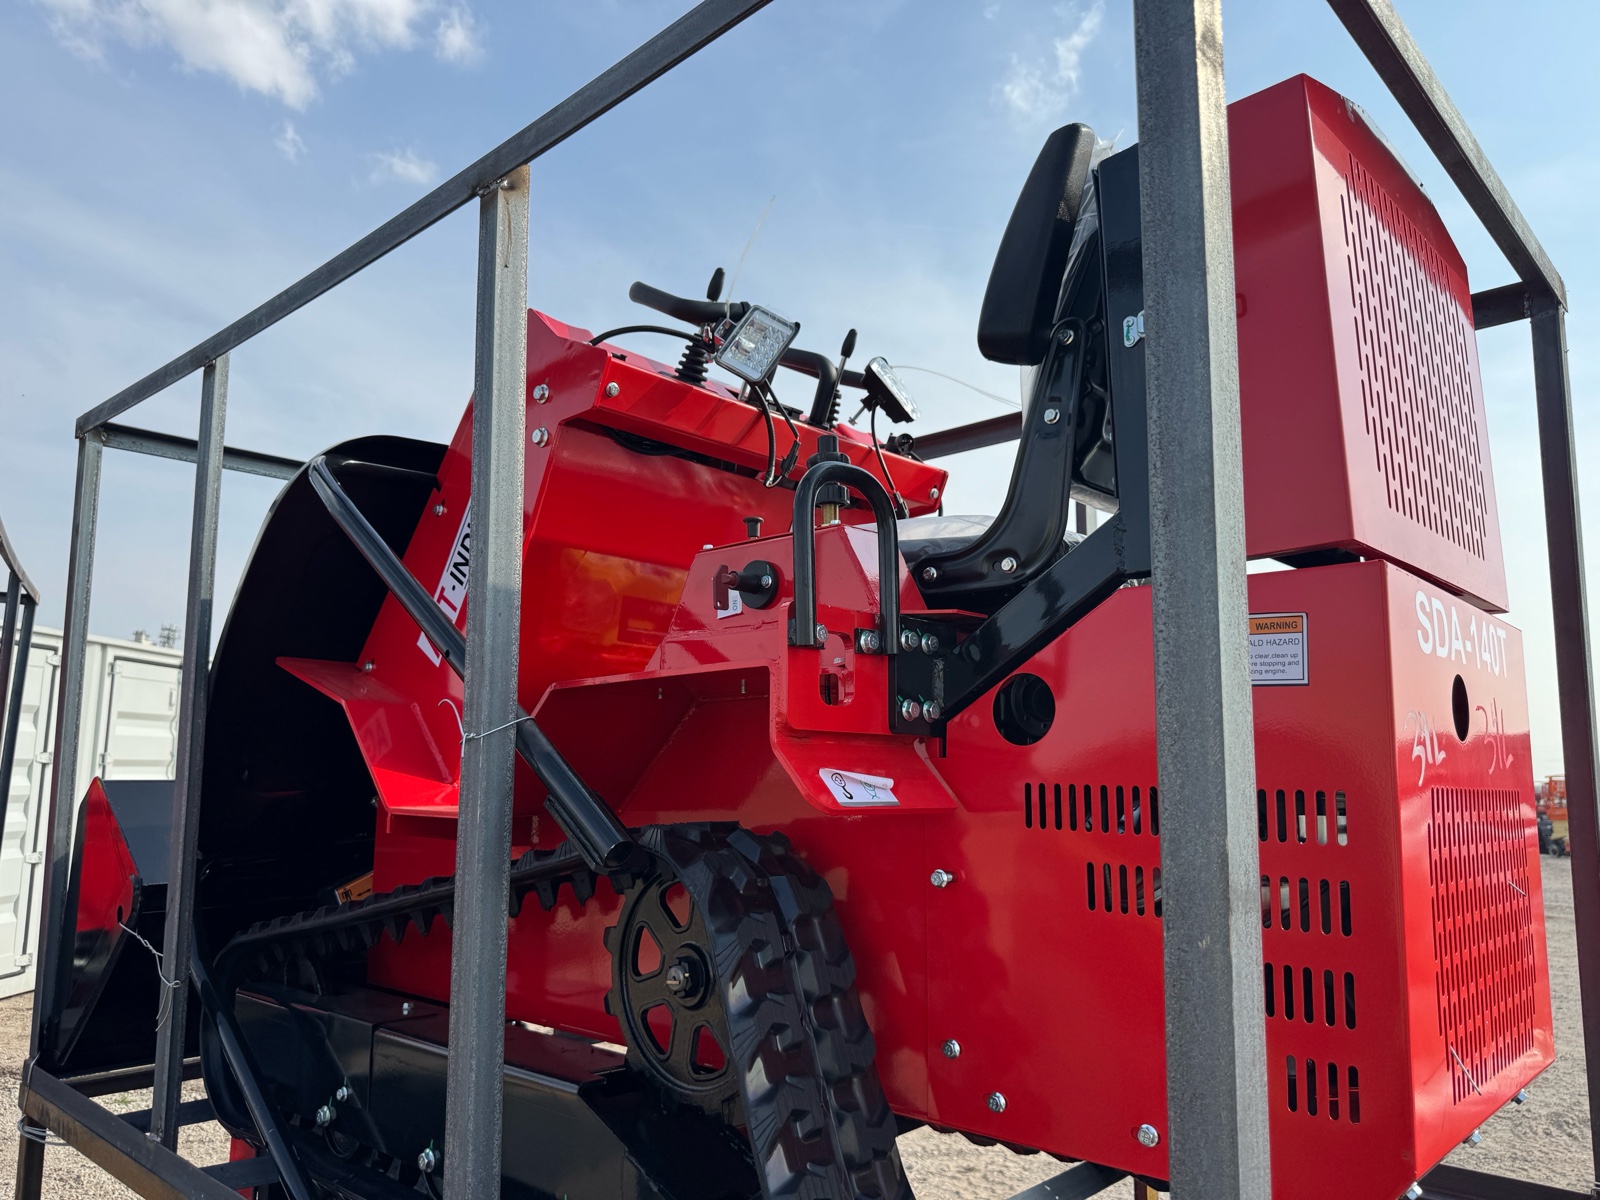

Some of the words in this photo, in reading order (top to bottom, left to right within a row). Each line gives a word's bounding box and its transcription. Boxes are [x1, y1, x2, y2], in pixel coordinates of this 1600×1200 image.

[1255, 620, 1298, 631] WARNING
[1415, 590, 1507, 679] SDA-140T
[1249, 639, 1264, 647] ALD
[1265, 637, 1300, 647] HAZARD
[1254, 652, 1289, 660] clear,clean
[1259, 660, 1286, 668] stopping
[1250, 668, 1263, 676] zing
[1264, 668, 1288, 676] engine.
